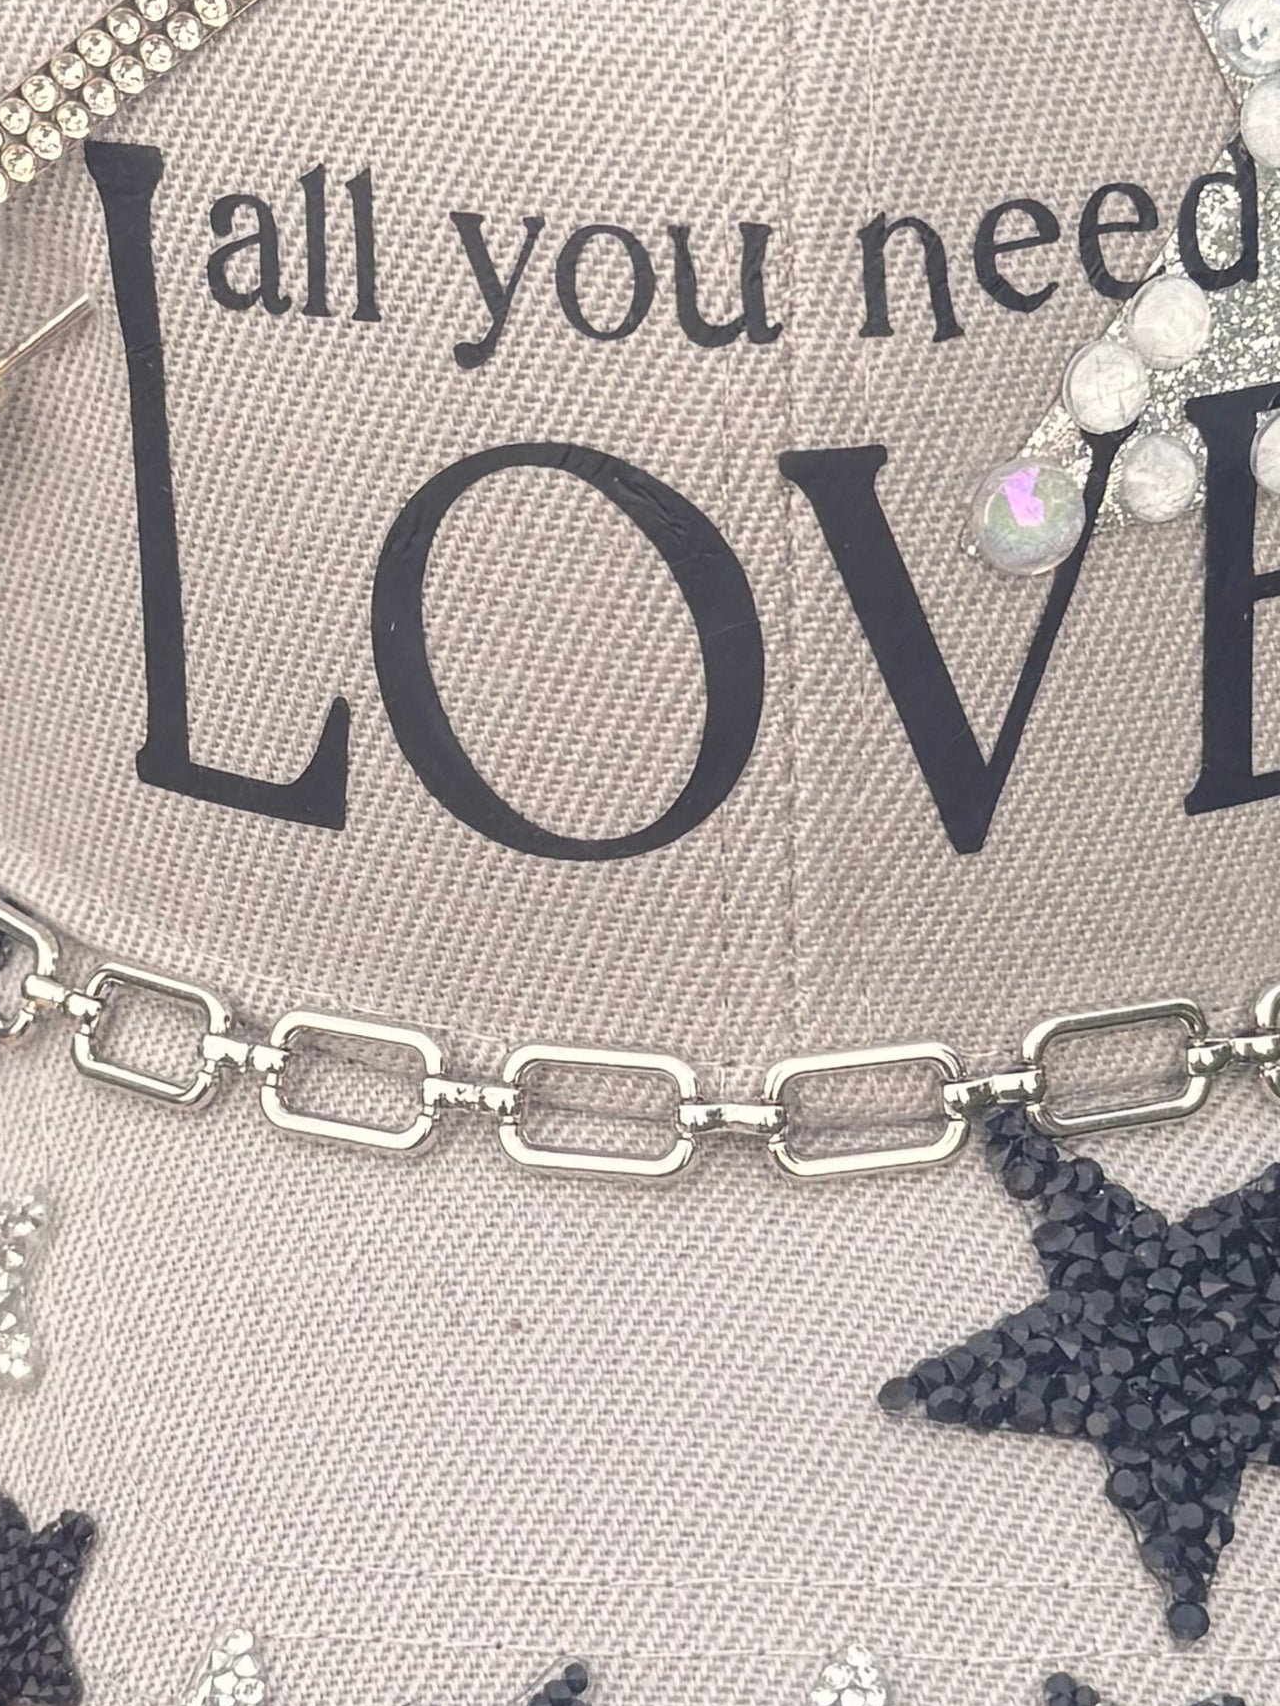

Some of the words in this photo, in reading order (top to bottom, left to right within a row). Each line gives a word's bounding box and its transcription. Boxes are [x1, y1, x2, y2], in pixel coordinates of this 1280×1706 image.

[205, 162, 381, 323] all
[451, 211, 783, 370] you
[856, 138, 1260, 343] need
